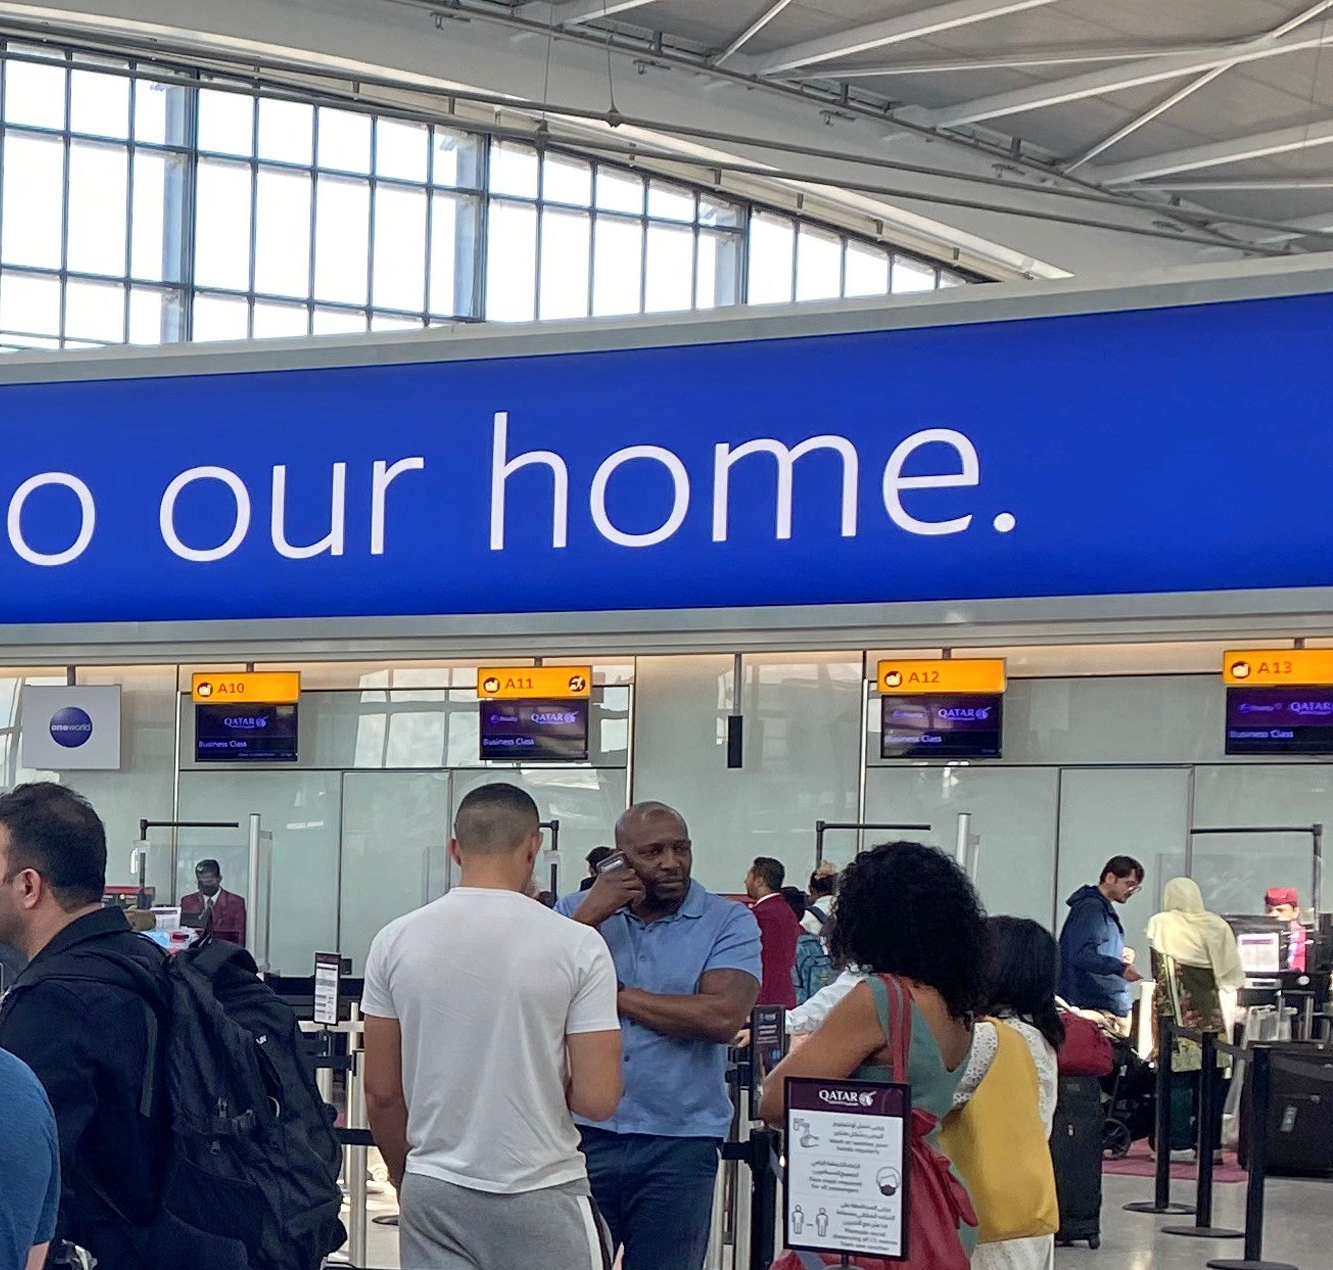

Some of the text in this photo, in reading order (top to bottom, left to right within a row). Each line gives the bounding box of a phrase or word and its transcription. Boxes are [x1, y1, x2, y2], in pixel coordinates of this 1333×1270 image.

[158, 454, 424, 563] our
[488, 411, 1016, 551] home.
[1258, 662, 1292, 674] A13
[908, 671, 940, 684] A12
[218, 683, 244, 694] A10
[505, 678, 533, 689] A11
[1290, 700, 1332, 714] QATAR
[531, 713, 563, 724] QATAR
[938, 707, 975, 720] QATAR
[51, 723, 91, 731] oneworld
[224, 717, 255, 728] QATAR
[199, 740, 246, 748] Business Class
[483, 738, 534, 746] Business Class
[921, 734, 942, 743] Class
[819, 1090, 858, 1103] QATAR
